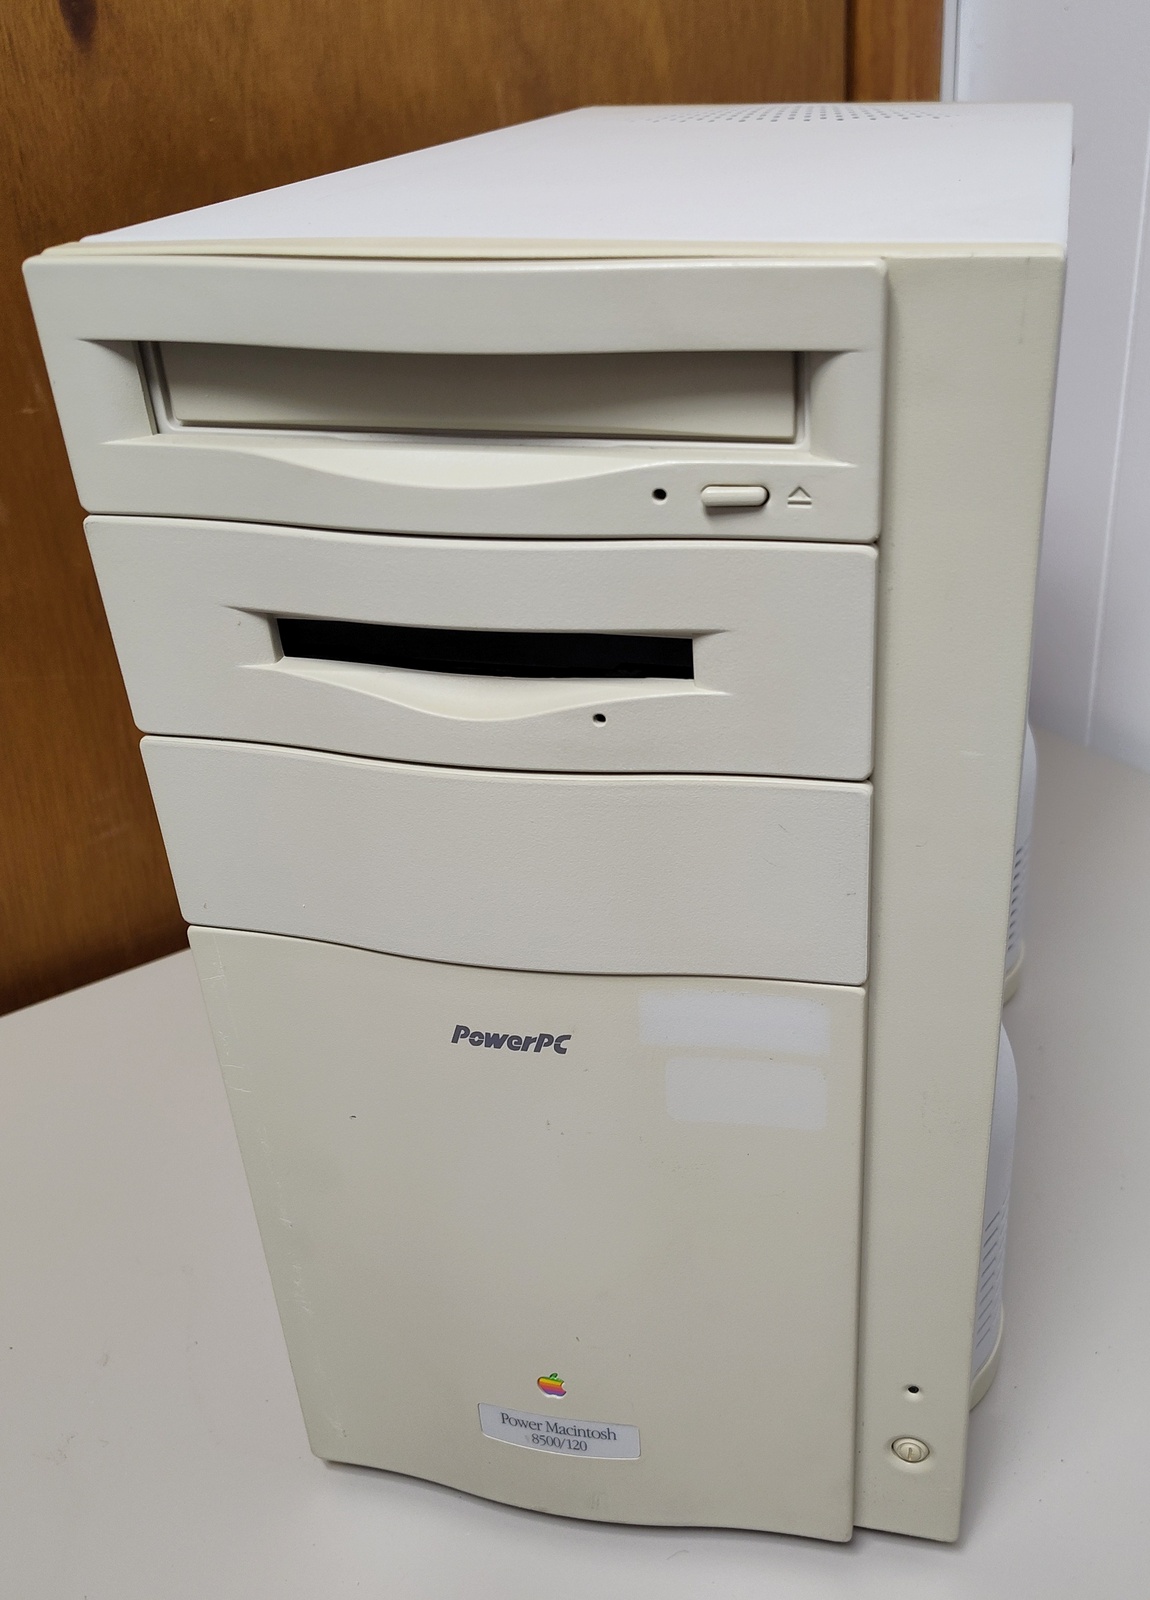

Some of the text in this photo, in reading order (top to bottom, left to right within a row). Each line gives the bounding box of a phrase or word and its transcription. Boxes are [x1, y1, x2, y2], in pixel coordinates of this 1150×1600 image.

[451, 1024, 572, 1055] PowerPC
[501, 1412, 617, 1441] Power Macintosh
[531, 1433, 588, 1451] 8500/120
